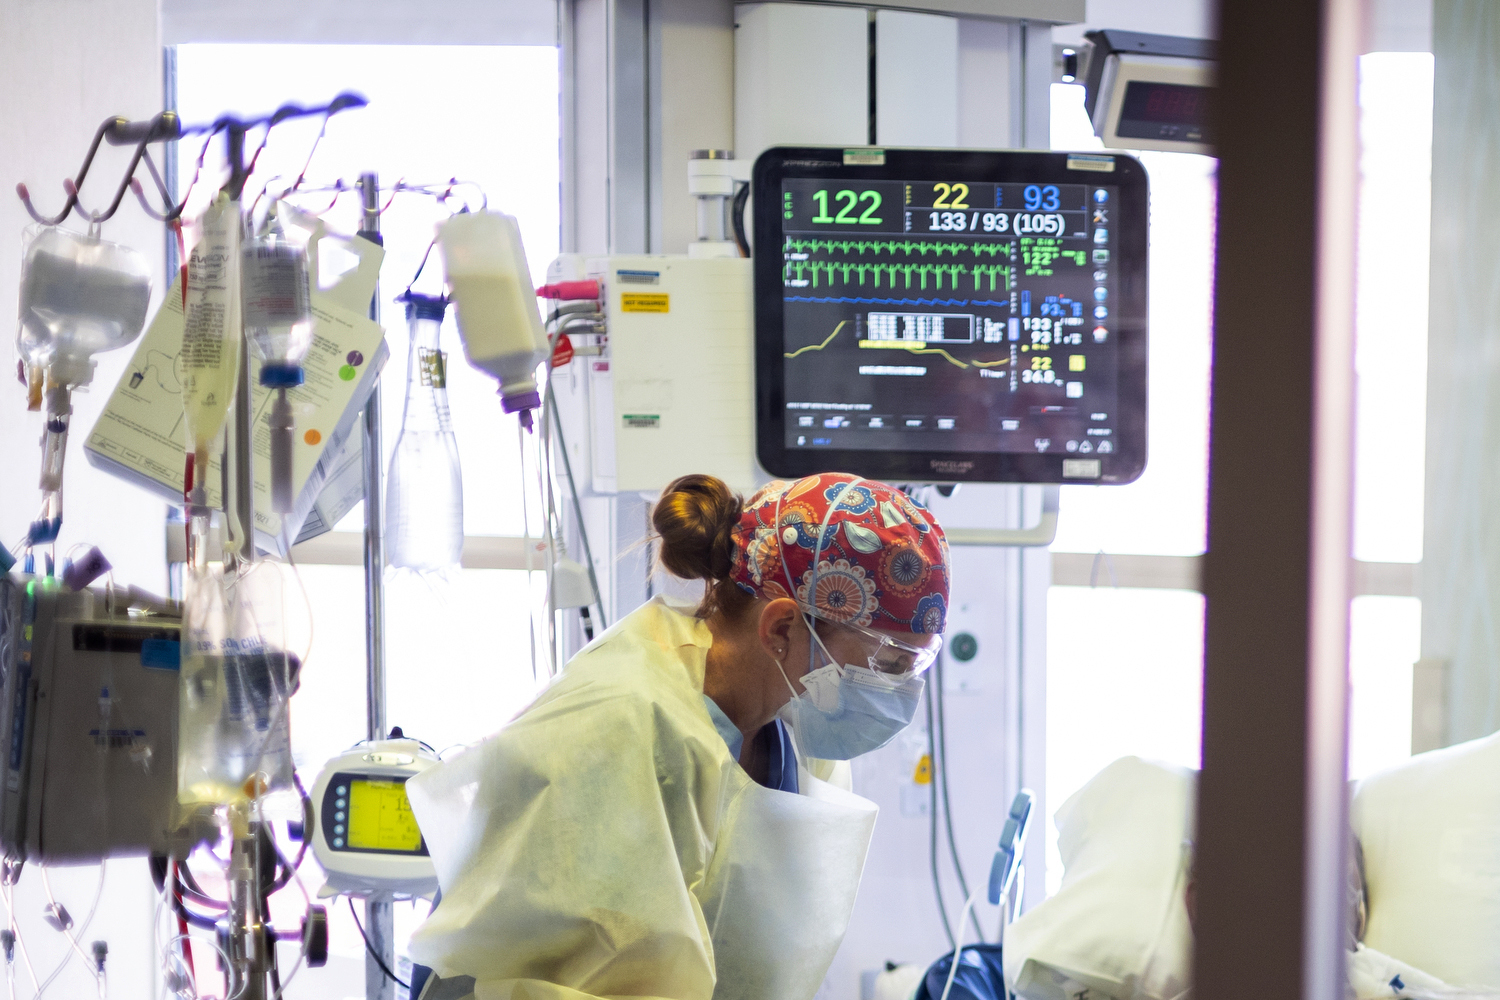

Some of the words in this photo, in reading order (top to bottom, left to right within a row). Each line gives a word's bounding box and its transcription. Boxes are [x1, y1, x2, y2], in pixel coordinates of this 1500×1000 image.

[811, 189, 883, 225] 122
[933, 182, 970, 210] 22
[1023, 184, 1061, 212] 93
[929, 211, 967, 232] 133
[970, 211, 980, 232] /
[982, 213, 1009, 232] 93
[1013, 213, 1066, 237] (105)
[1022, 251, 1052, 266] 122
[1022, 317, 1052, 331] 133
[1031, 356, 1053, 371] 22
